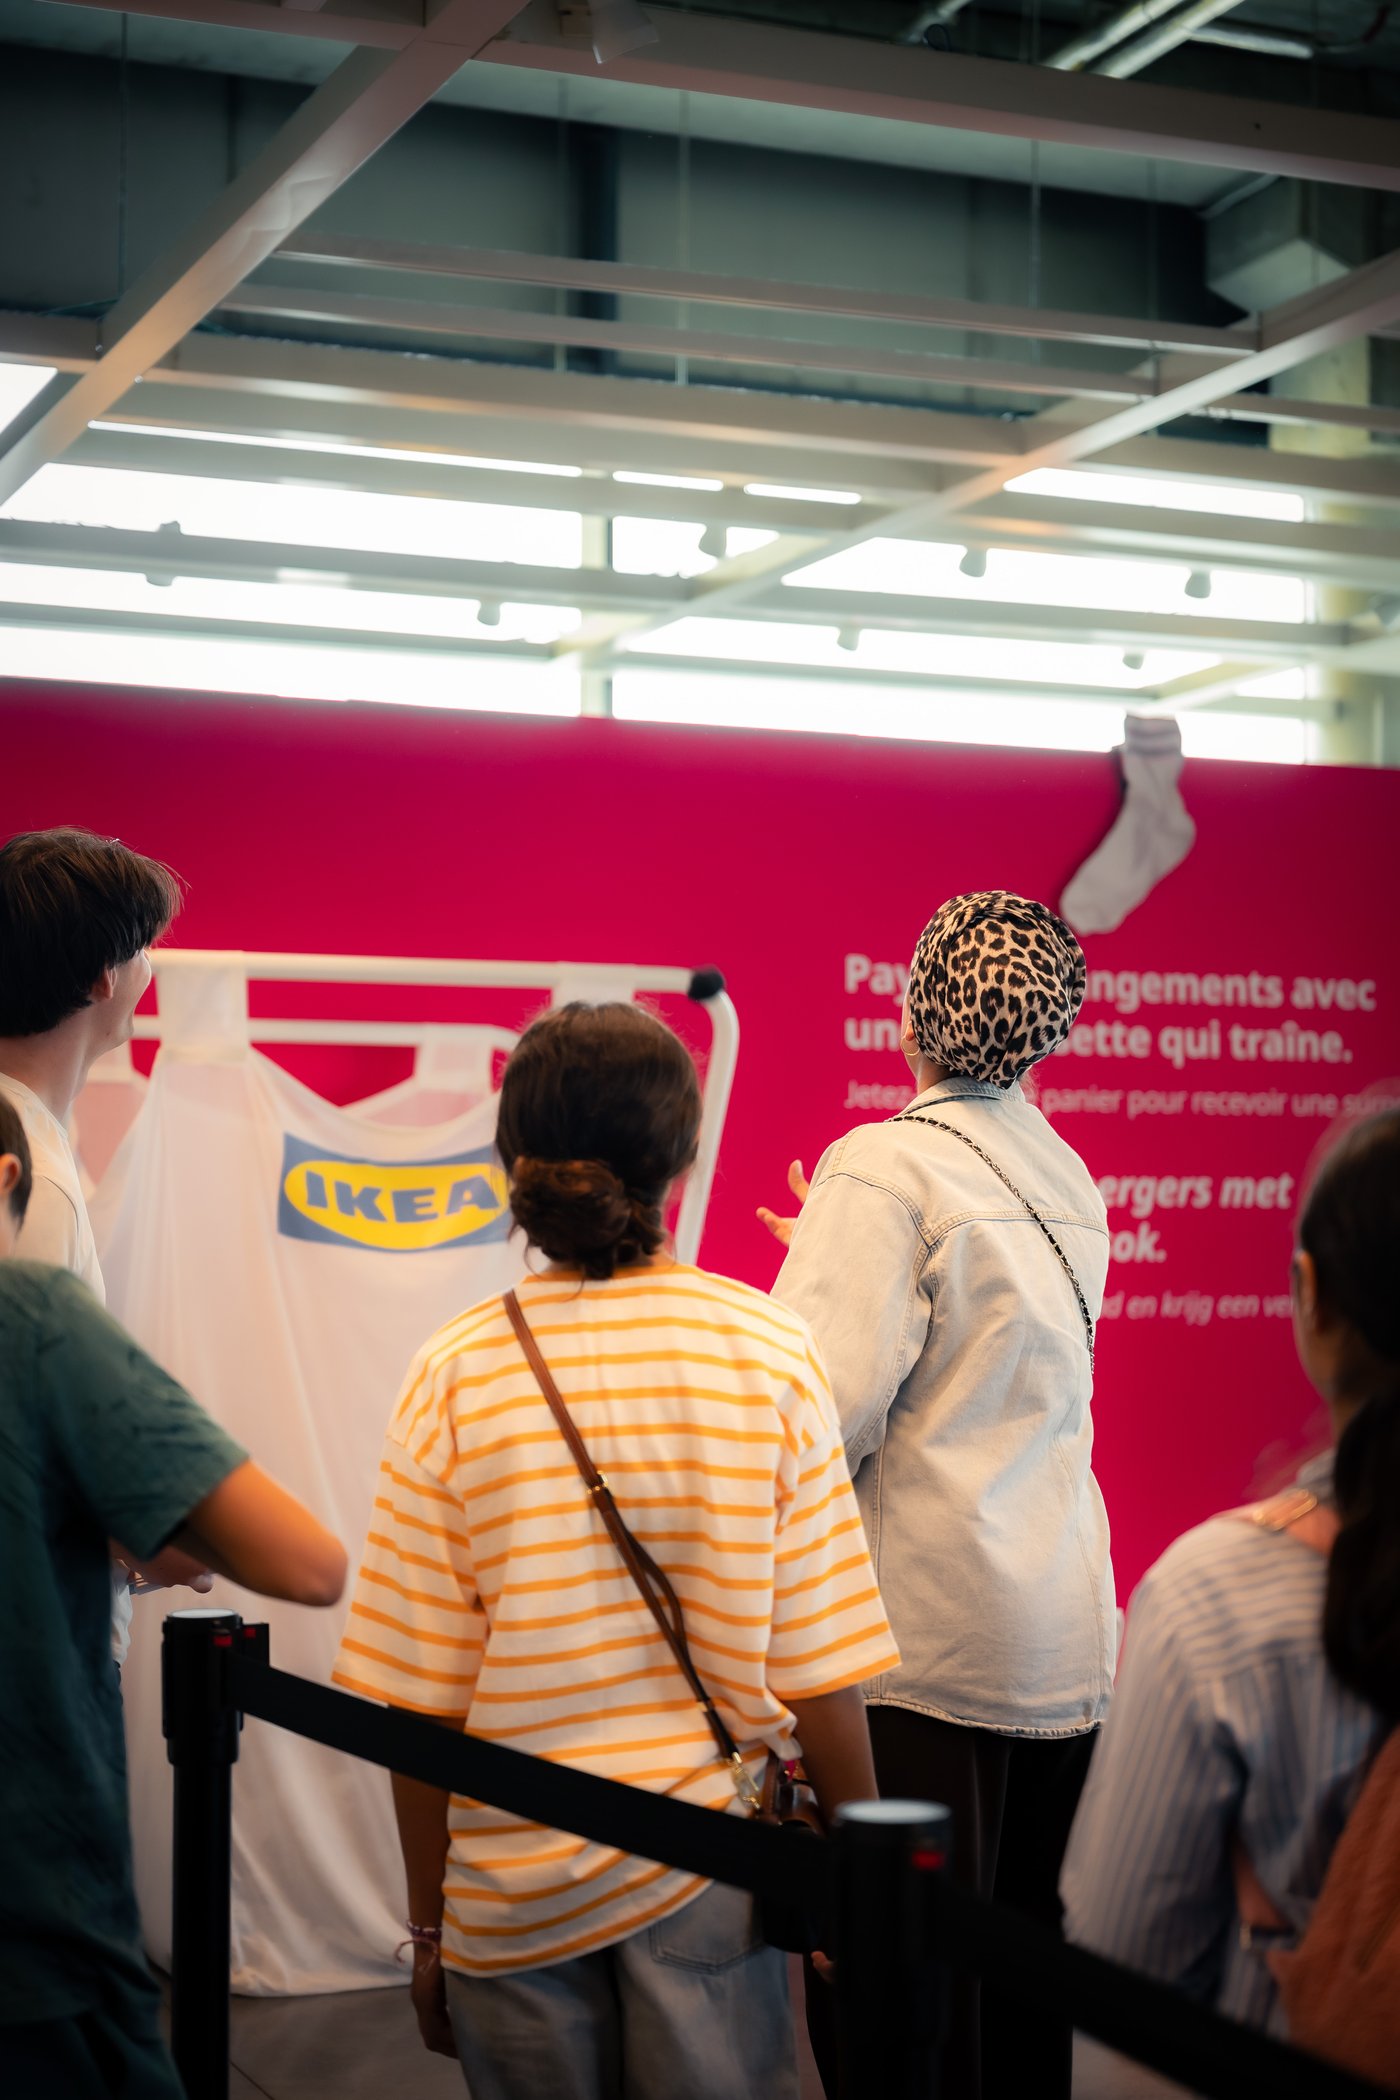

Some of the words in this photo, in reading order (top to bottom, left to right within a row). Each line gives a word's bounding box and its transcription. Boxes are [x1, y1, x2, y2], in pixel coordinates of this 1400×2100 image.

[844, 953, 911, 1007] Pay
[1083, 969, 1284, 1014] ngements
[1291, 976, 1377, 1012] avec
[844, 1017, 903, 1051] un
[1158, 1018, 1221, 1069] qui
[1228, 1019, 1353, 1064] traîne.
[1041, 1084, 1124, 1117] panier
[1126, 1089, 1188, 1120] pour
[1190, 1087, 1288, 1116] recevoir
[1291, 1093, 1338, 1117] une
[306, 1169, 500, 1223] IKEA
[1097, 1174, 1213, 1219] ergers
[1218, 1172, 1294, 1210] met
[1109, 1220, 1167, 1263] ok.
[1125, 1295, 1158, 1320] en
[1160, 1289, 1214, 1326] krijg
[1216, 1294, 1260, 1319] een
